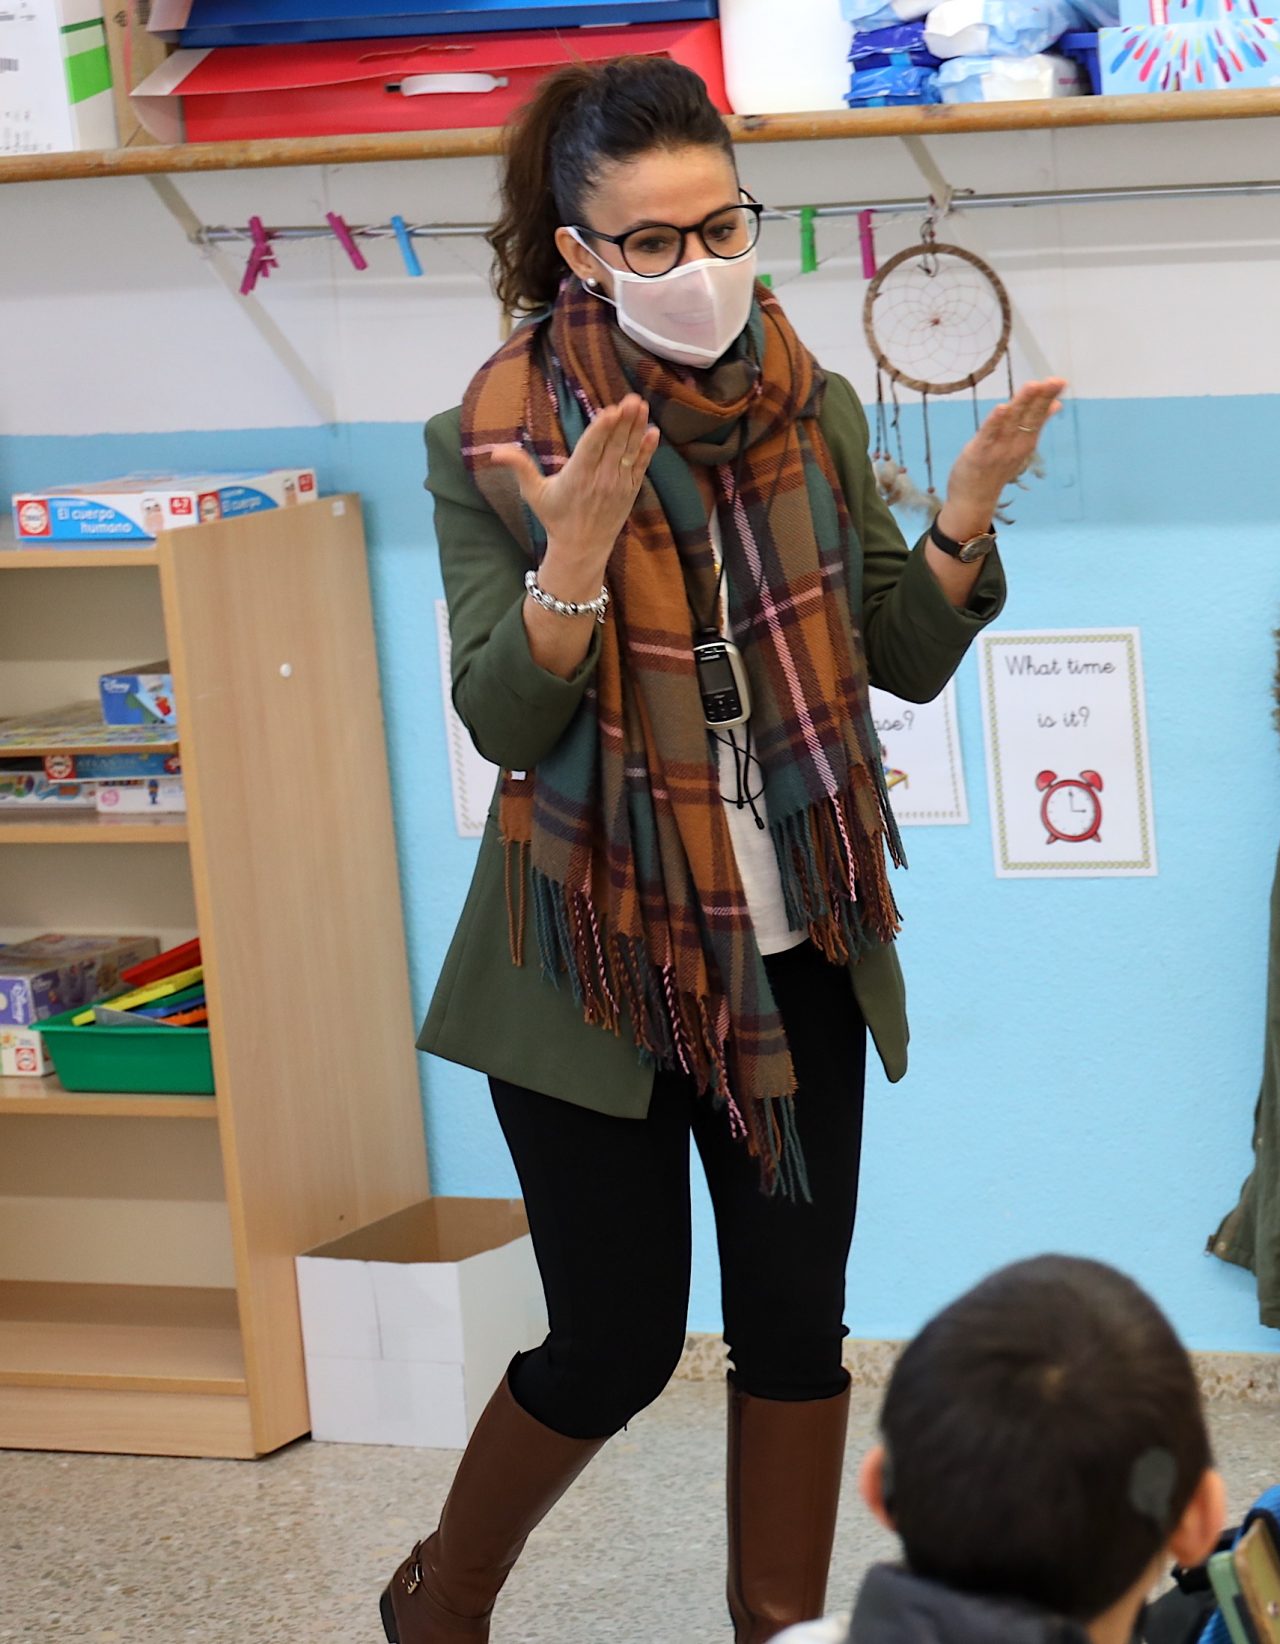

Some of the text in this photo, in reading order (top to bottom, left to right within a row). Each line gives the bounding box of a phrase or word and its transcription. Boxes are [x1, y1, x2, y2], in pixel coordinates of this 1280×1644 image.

[57, 507, 69, 521] El
[71, 509, 115, 522] cuerpo
[80, 522, 133, 534] humano
[1004, 655, 1116, 676] What time
[1037, 705, 1091, 728] is it?
